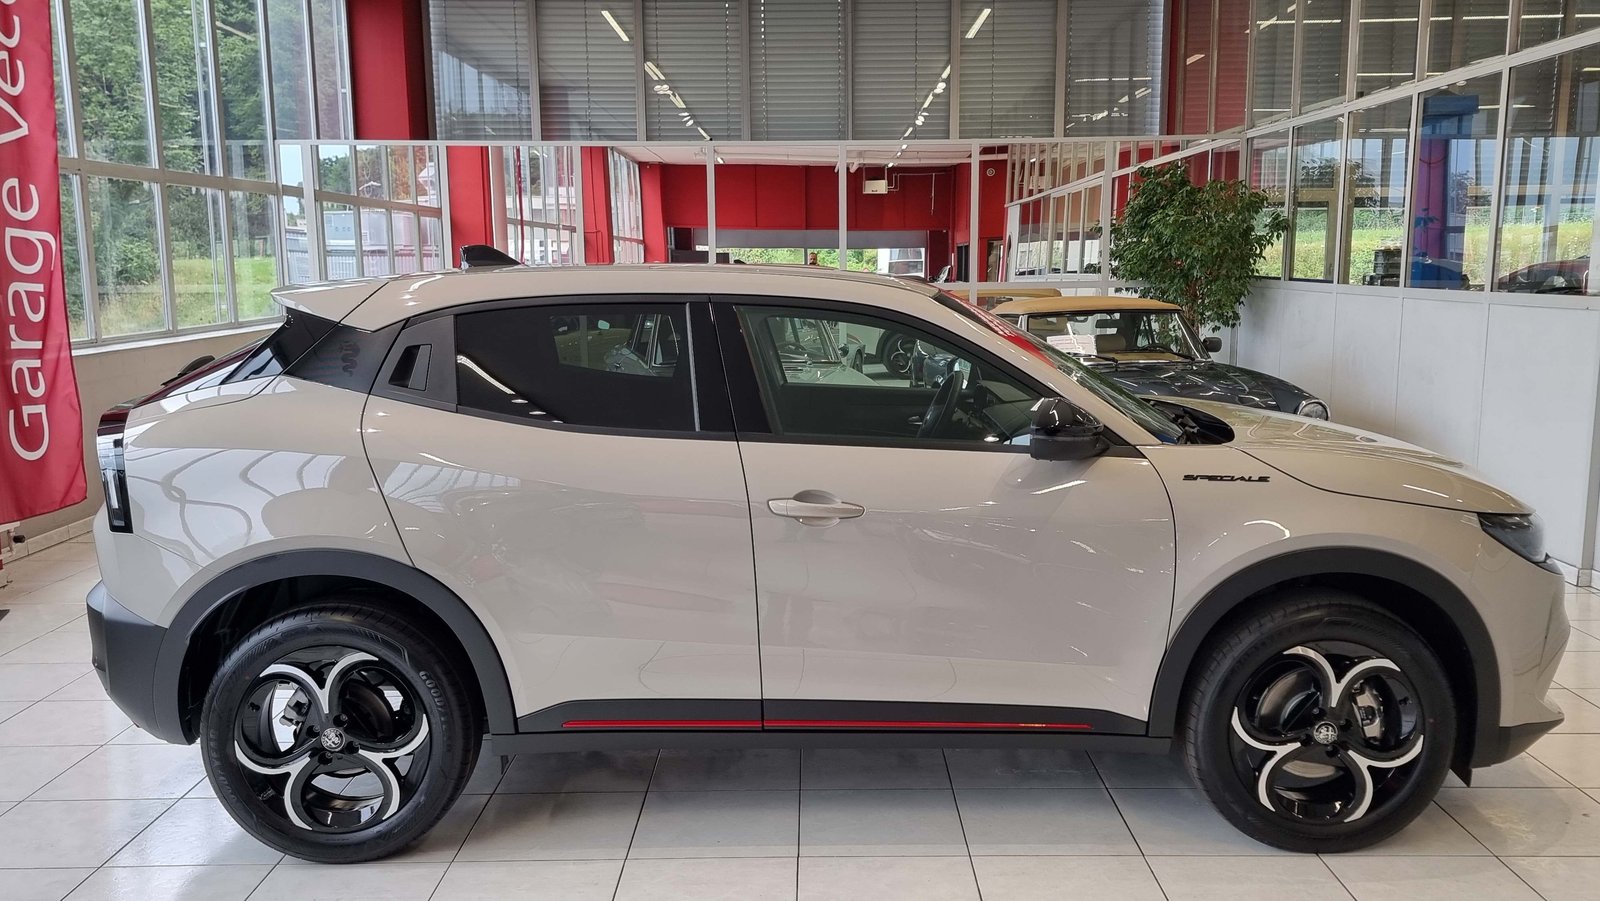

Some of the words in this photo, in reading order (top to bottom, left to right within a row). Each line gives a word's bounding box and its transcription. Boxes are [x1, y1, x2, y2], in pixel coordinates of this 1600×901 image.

[0, 0, 29, 144] Vec
[1, 177, 57, 461] Garage
[1182, 474, 1271, 483] SPECIALE
[208, 728, 240, 805] OODYEAR
